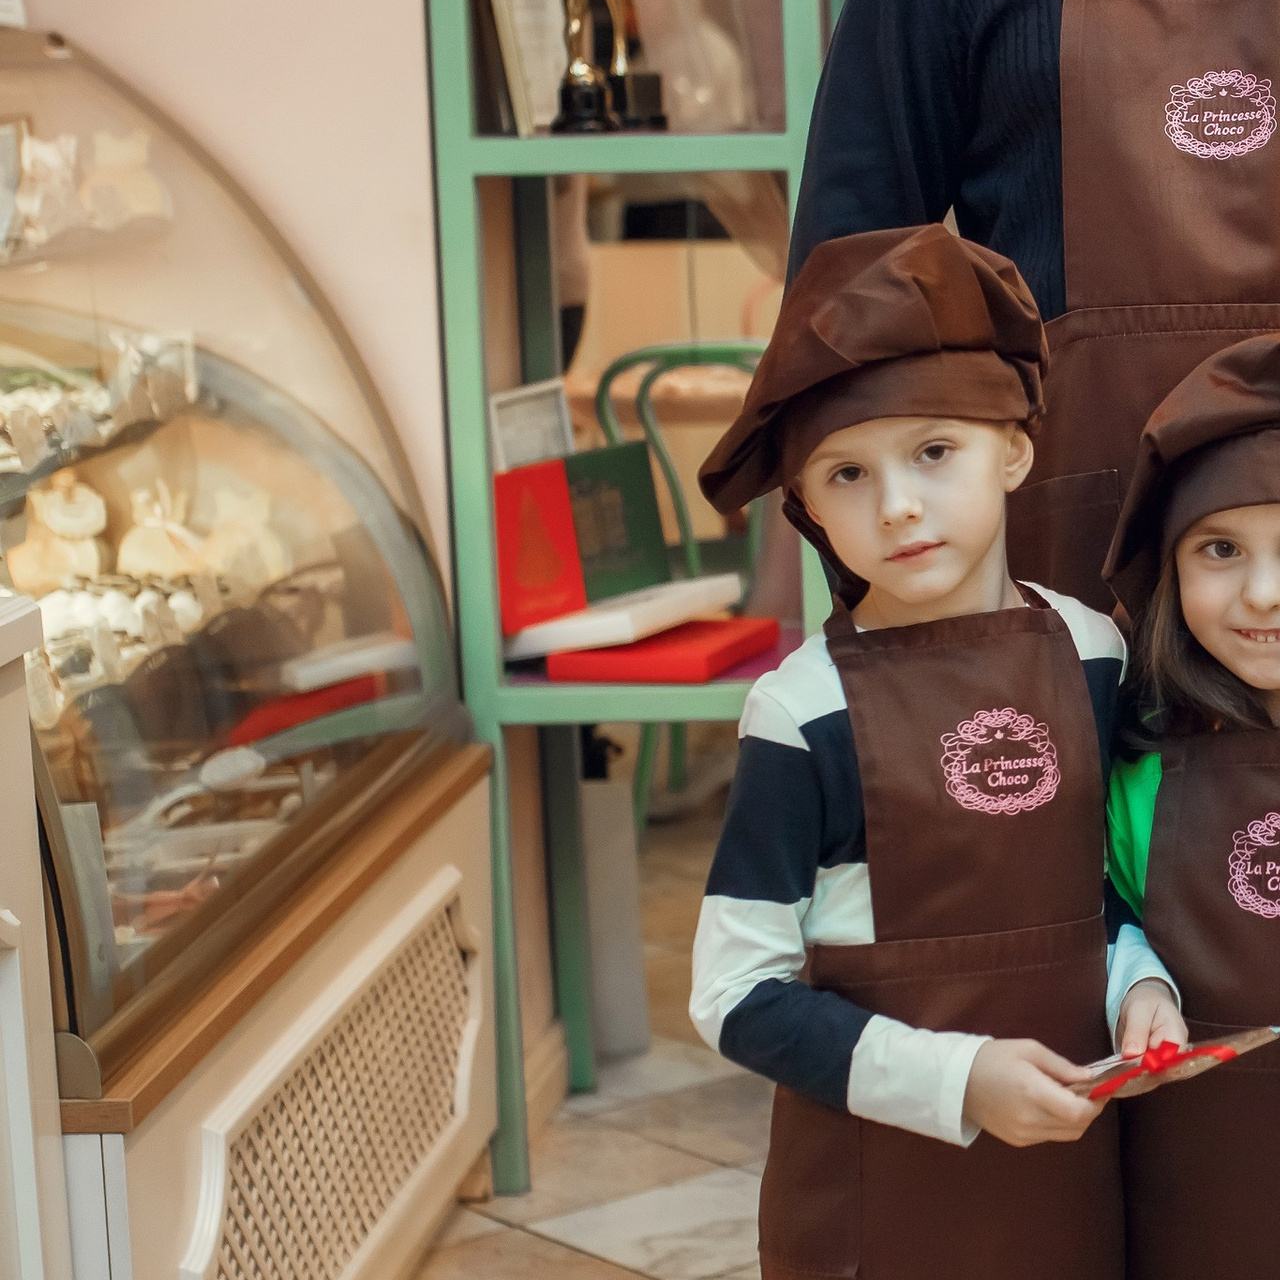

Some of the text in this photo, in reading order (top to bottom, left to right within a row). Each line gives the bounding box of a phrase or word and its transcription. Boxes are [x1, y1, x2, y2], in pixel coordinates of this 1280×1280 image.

[1181, 109, 1262, 123] La Princesse
[1203, 123, 1244, 136] Choco
[962, 756, 1044, 774] La Princesse
[987, 772, 1029, 787] Choco
[1246, 861, 1262, 875] La
